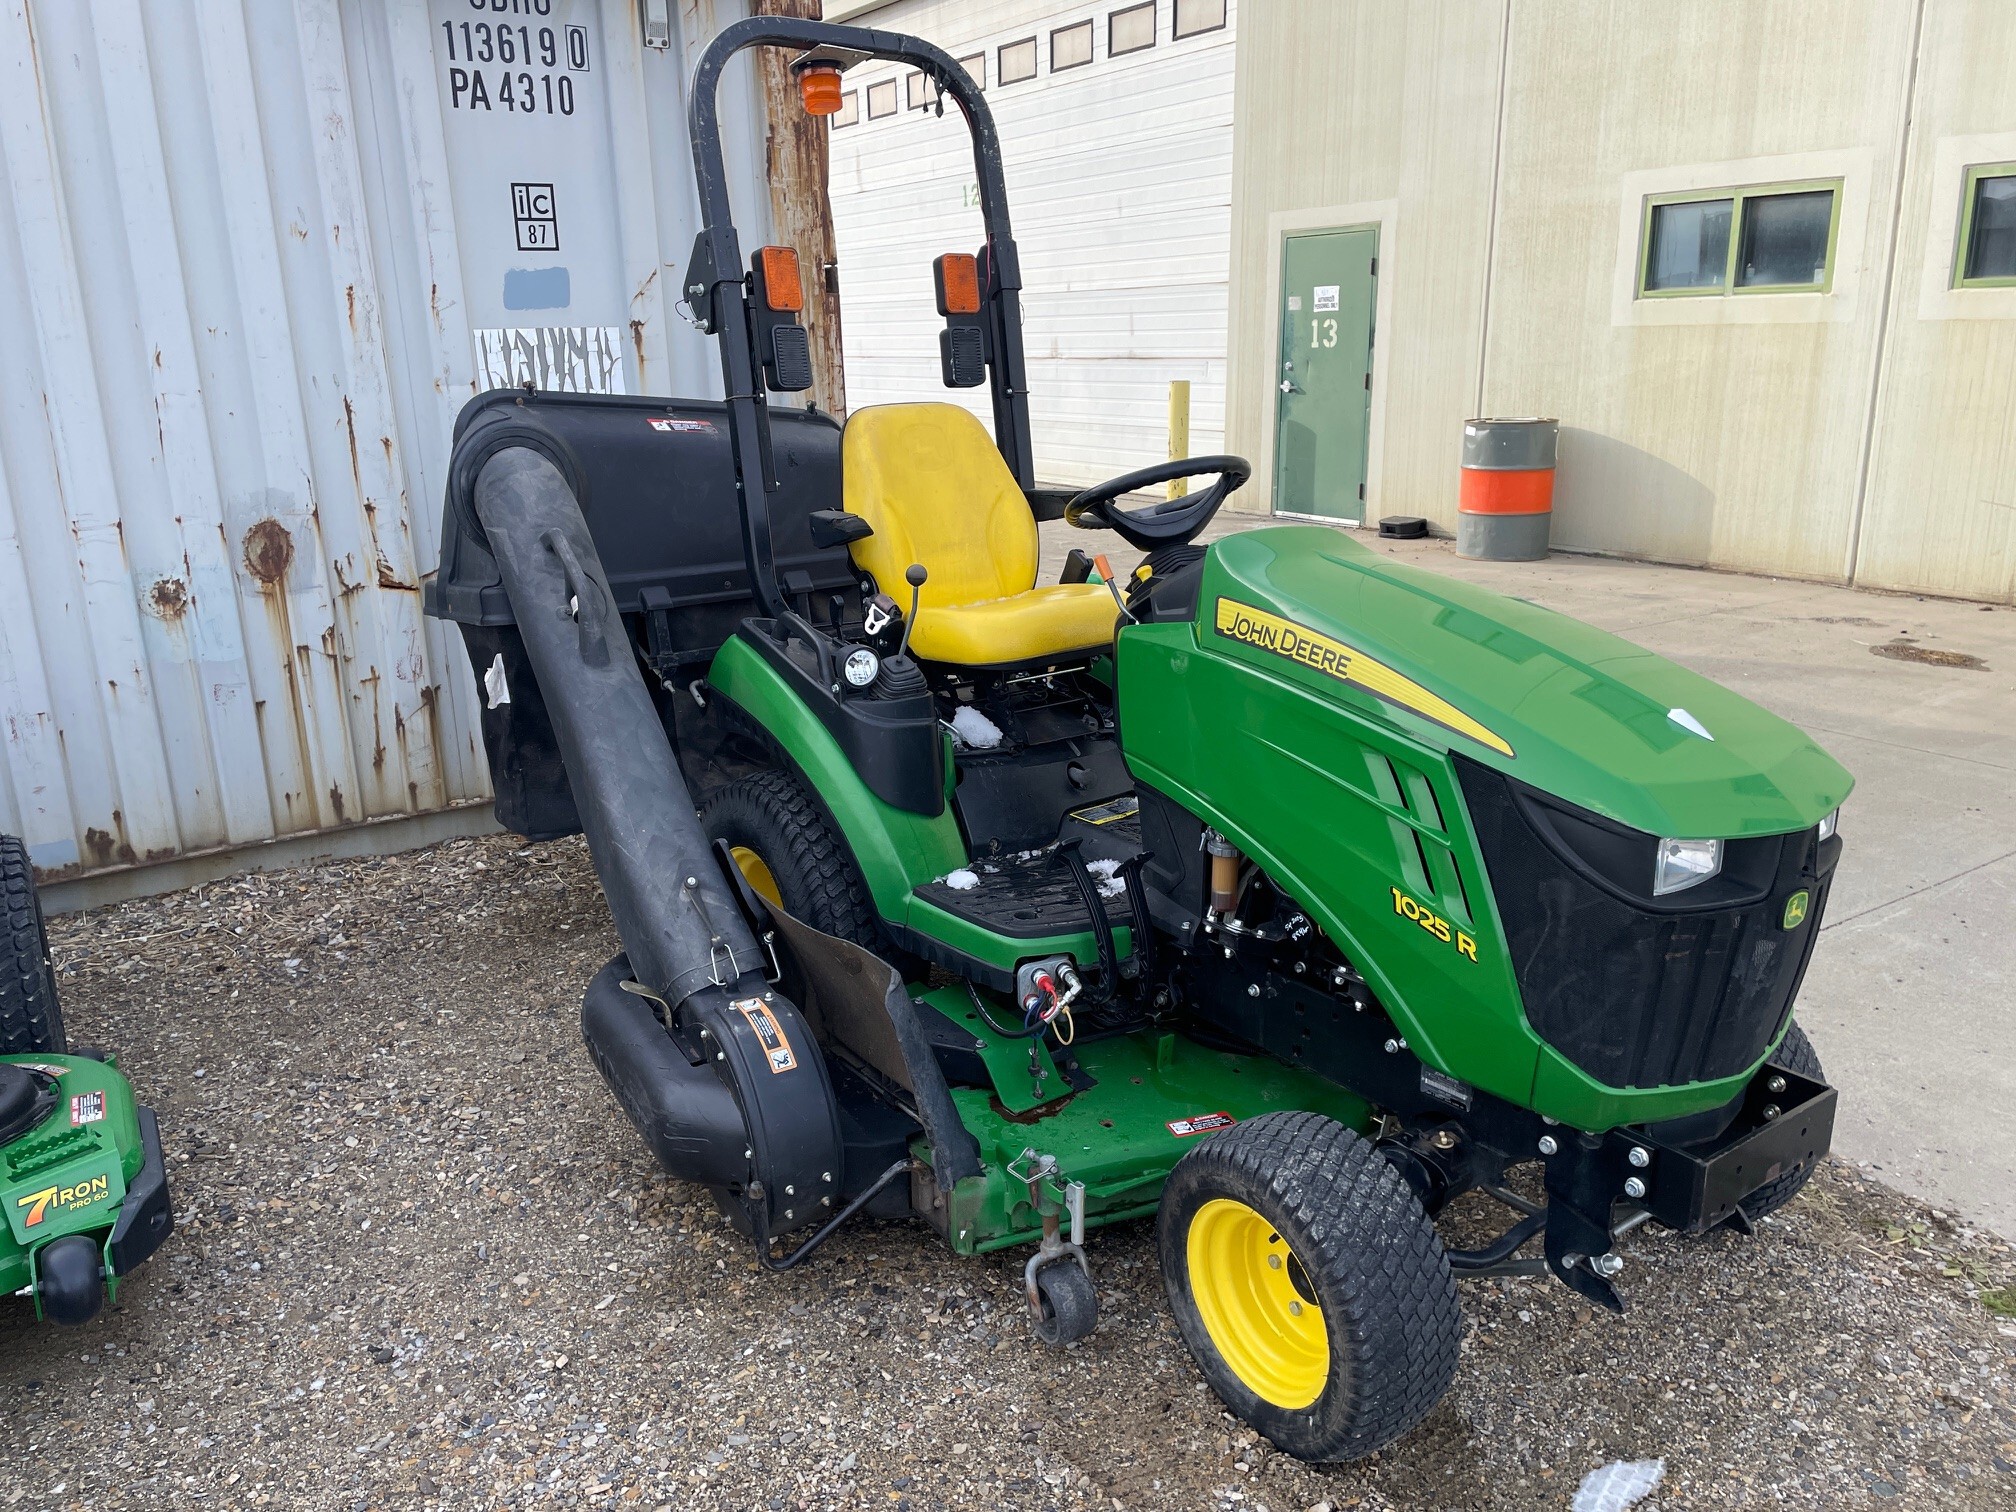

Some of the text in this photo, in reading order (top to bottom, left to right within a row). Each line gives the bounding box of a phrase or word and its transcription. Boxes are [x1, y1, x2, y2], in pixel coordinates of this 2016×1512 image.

[442, 20, 585, 68] 113619 0
[450, 67, 574, 116] PA 4310
[528, 224, 546, 244] 87
[1311, 318, 1338, 348] 13
[1226, 612, 1352, 677] JOHN DEERE
[1390, 886, 1478, 964] 1025 R
[69, 1190, 109, 1212] PRO 60
